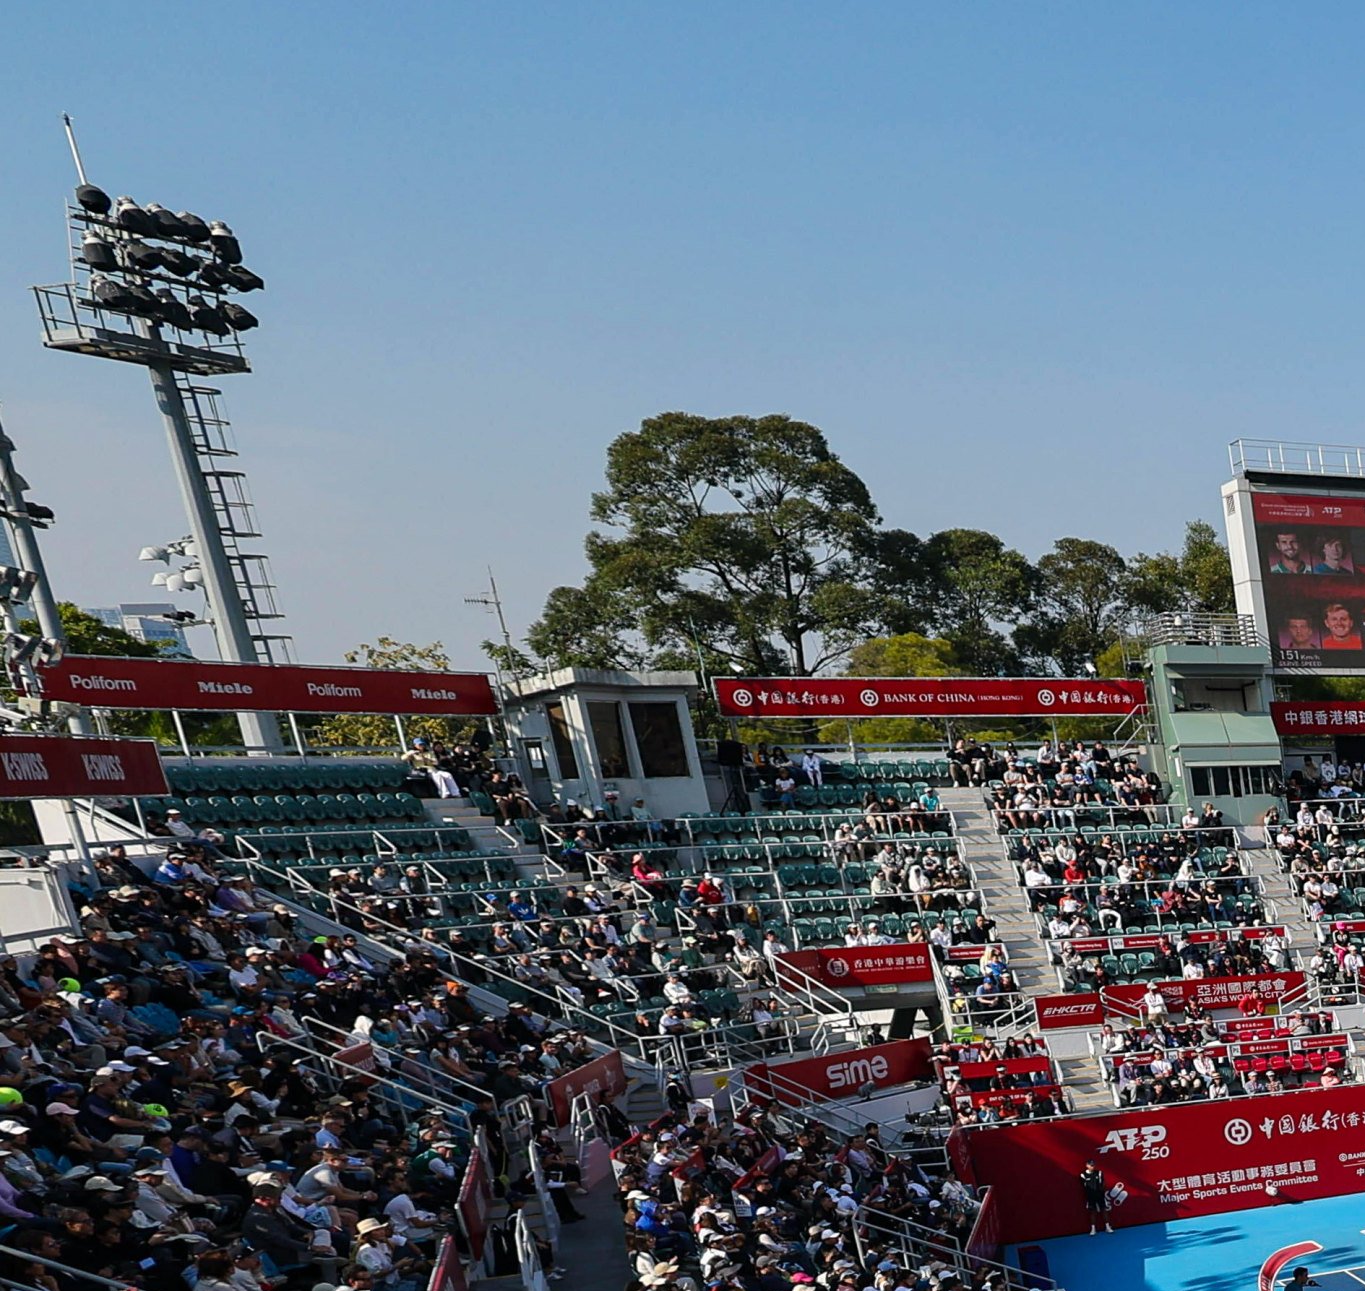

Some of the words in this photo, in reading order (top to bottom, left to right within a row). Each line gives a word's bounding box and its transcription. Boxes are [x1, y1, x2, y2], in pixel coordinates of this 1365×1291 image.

[1280, 650, 1299, 660] 151
[69, 674, 137, 691] Poliform
[197, 681, 253, 695] Miele
[307, 682, 362, 697] Poliform
[411, 688, 456, 700] Miele
[883, 693, 917, 702] BANK
[919, 693, 934, 702] OF
[937, 693, 975, 702] CHINA
[1053, 1003, 1096, 1015] HKCTA
[1096, 1125, 1167, 1153] ATP
[1141, 1146, 1170, 1160] 250
[1160, 1190, 1190, 1204] Major
[1193, 1186, 1228, 1200] Sports
[1230, 1182, 1264, 1195] Events
[1266, 1174, 1319, 1191] Committee
